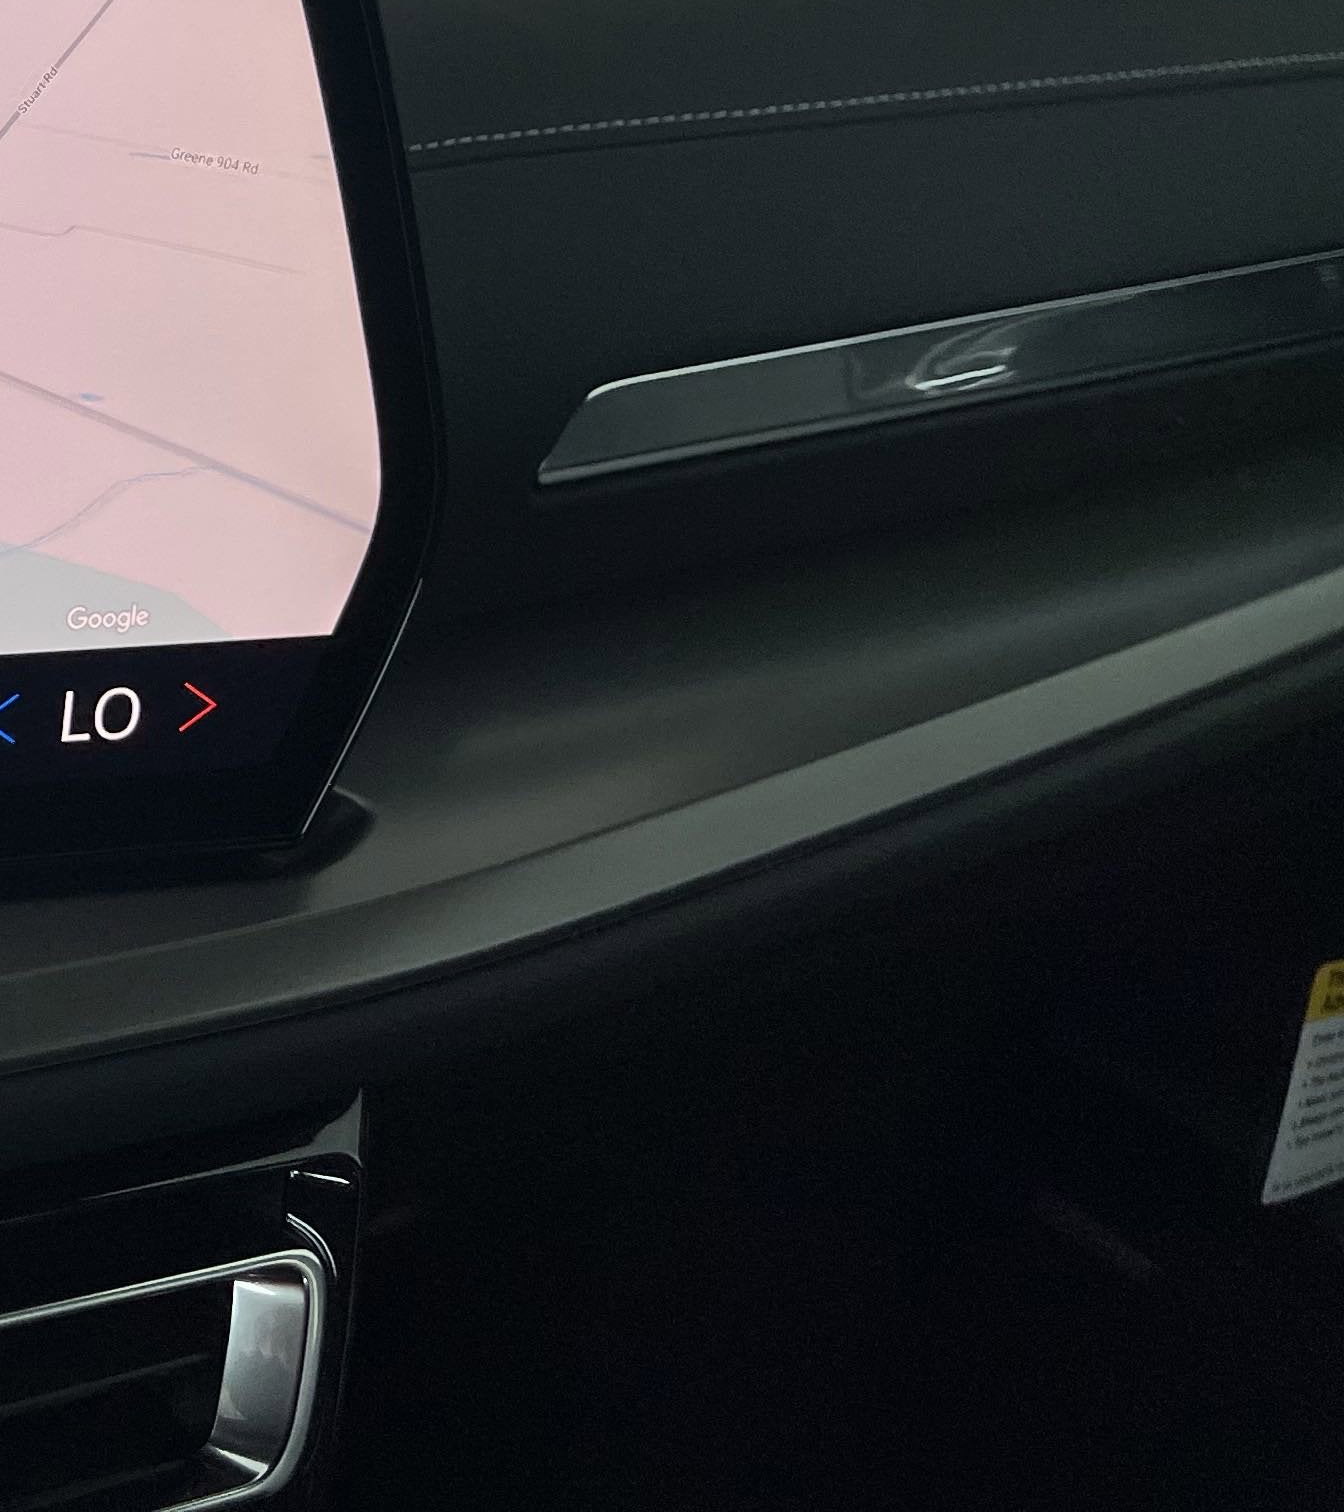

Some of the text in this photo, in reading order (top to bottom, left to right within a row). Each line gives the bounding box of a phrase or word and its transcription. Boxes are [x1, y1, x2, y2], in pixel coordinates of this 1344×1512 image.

[18, 66, 58, 114] Stuart Rd
[171, 147, 259, 175] Greene 904 Rd
[67, 605, 149, 633] Google
[60, 687, 141, 743] LO
